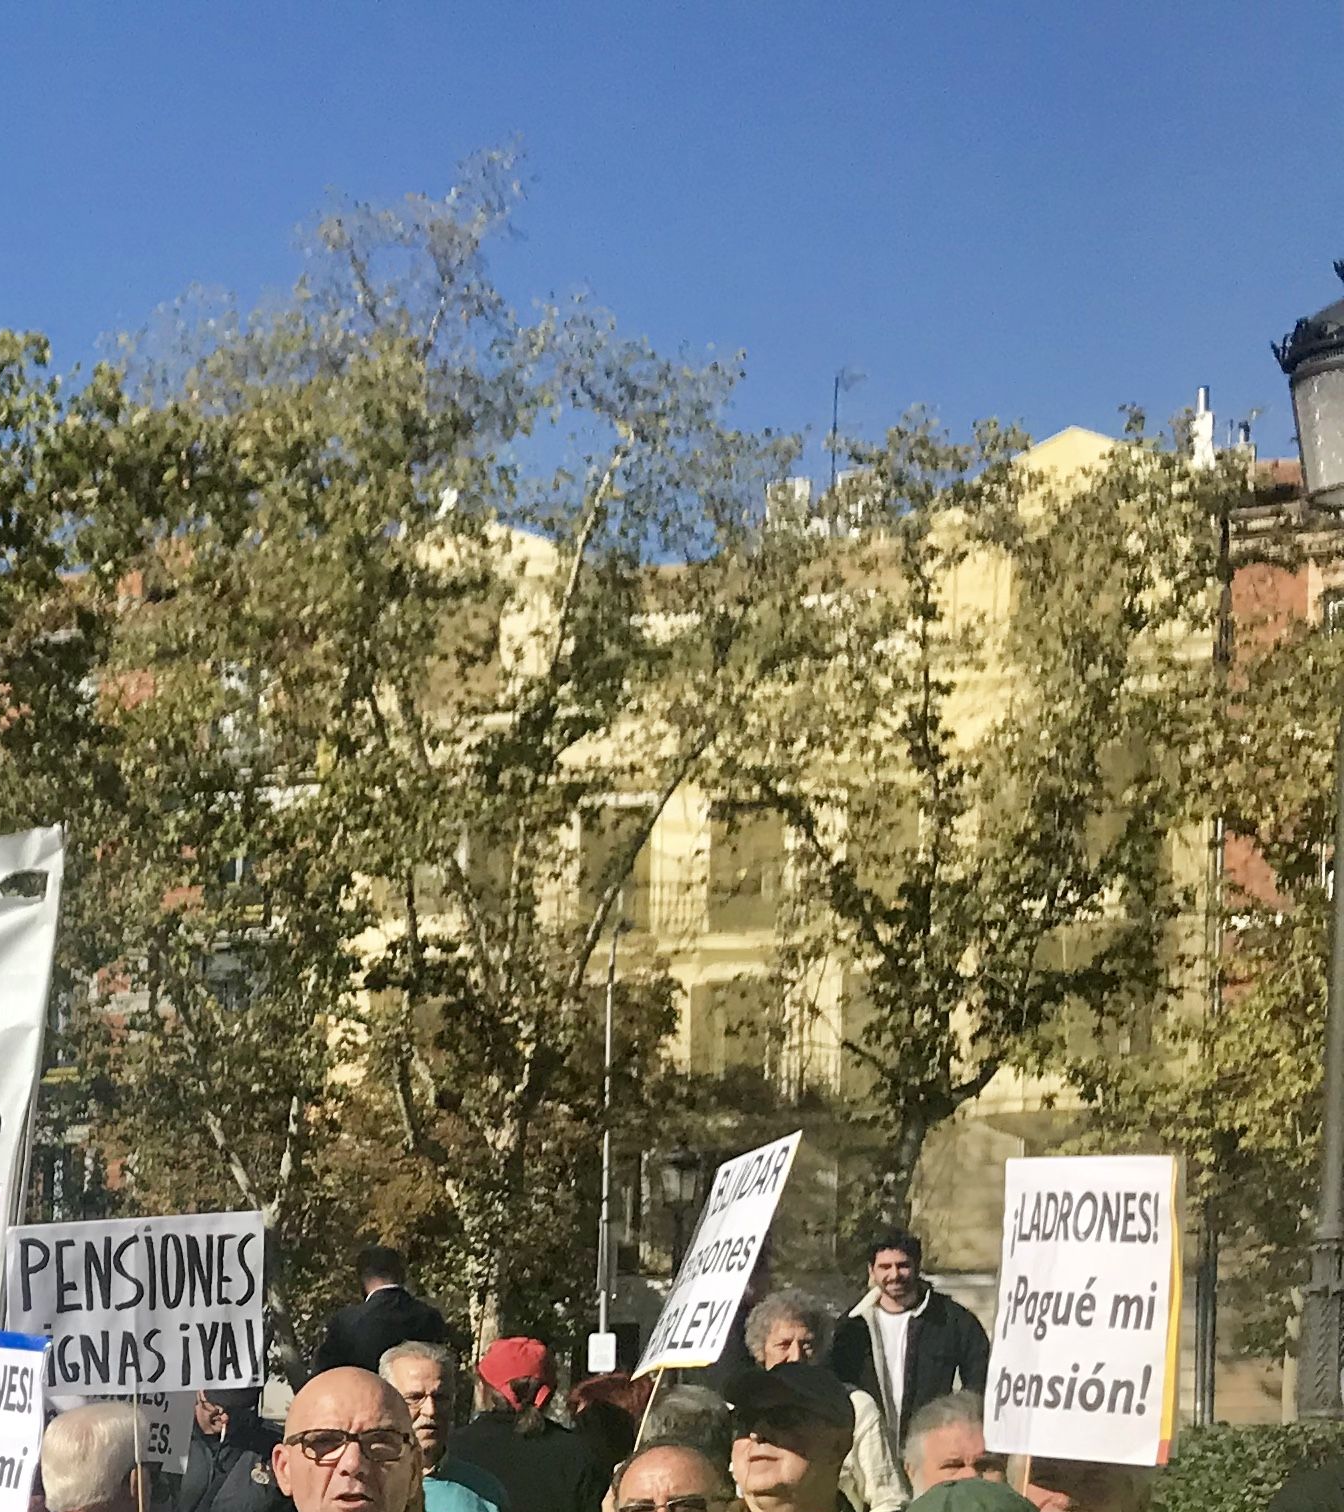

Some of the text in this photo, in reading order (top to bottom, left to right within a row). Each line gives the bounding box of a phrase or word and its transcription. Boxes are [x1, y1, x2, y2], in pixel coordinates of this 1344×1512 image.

[1011, 1189, 1159, 1260] ¡LADRONES!
[667, 1300, 732, 1350] LEY!
[1006, 1273, 1157, 1342] ¡Pagué mi
[180, 1320, 260, 1387] ¡YA!
[995, 1362, 1153, 1422] pensión!
